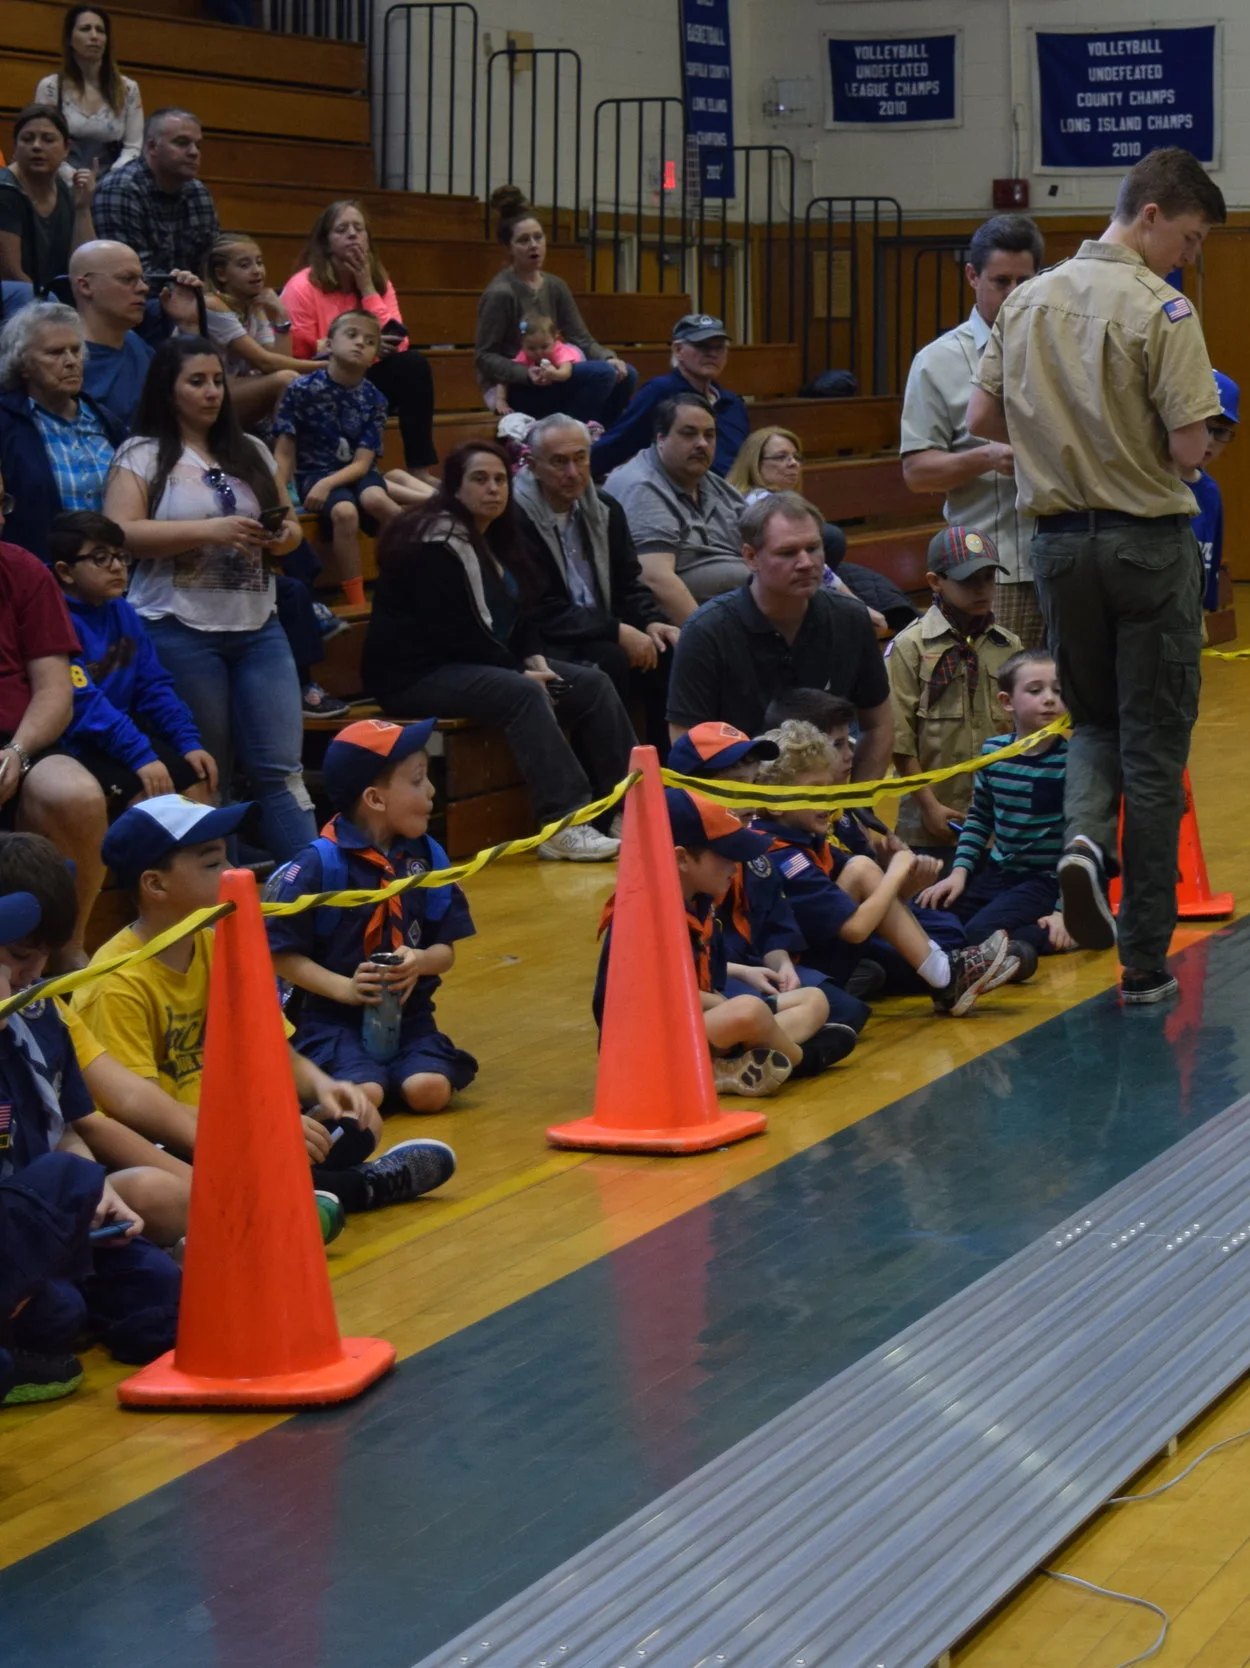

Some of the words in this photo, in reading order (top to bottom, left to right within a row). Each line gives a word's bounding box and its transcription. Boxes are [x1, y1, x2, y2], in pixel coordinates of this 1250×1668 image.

[855, 44, 928, 61] VOLLEYBALL
[1087, 38, 1162, 55] VOLLEYBALL
[856, 62, 928, 78] UNDEFEATED
[1088, 64, 1163, 82] UNDEFEATED
[845, 81, 889, 98] LEAGUE
[895, 80, 940, 96] CHAMPS
[1077, 91, 1122, 108] COUNTY
[1129, 90, 1175, 105] CHAMPS
[878, 101, 907, 116] 2010
[1060, 117, 1091, 133] LONG
[1098, 116, 1141, 132] ISLAND
[1147, 114, 1193, 130] CHAMPS
[1112, 142, 1141, 157] 2010
